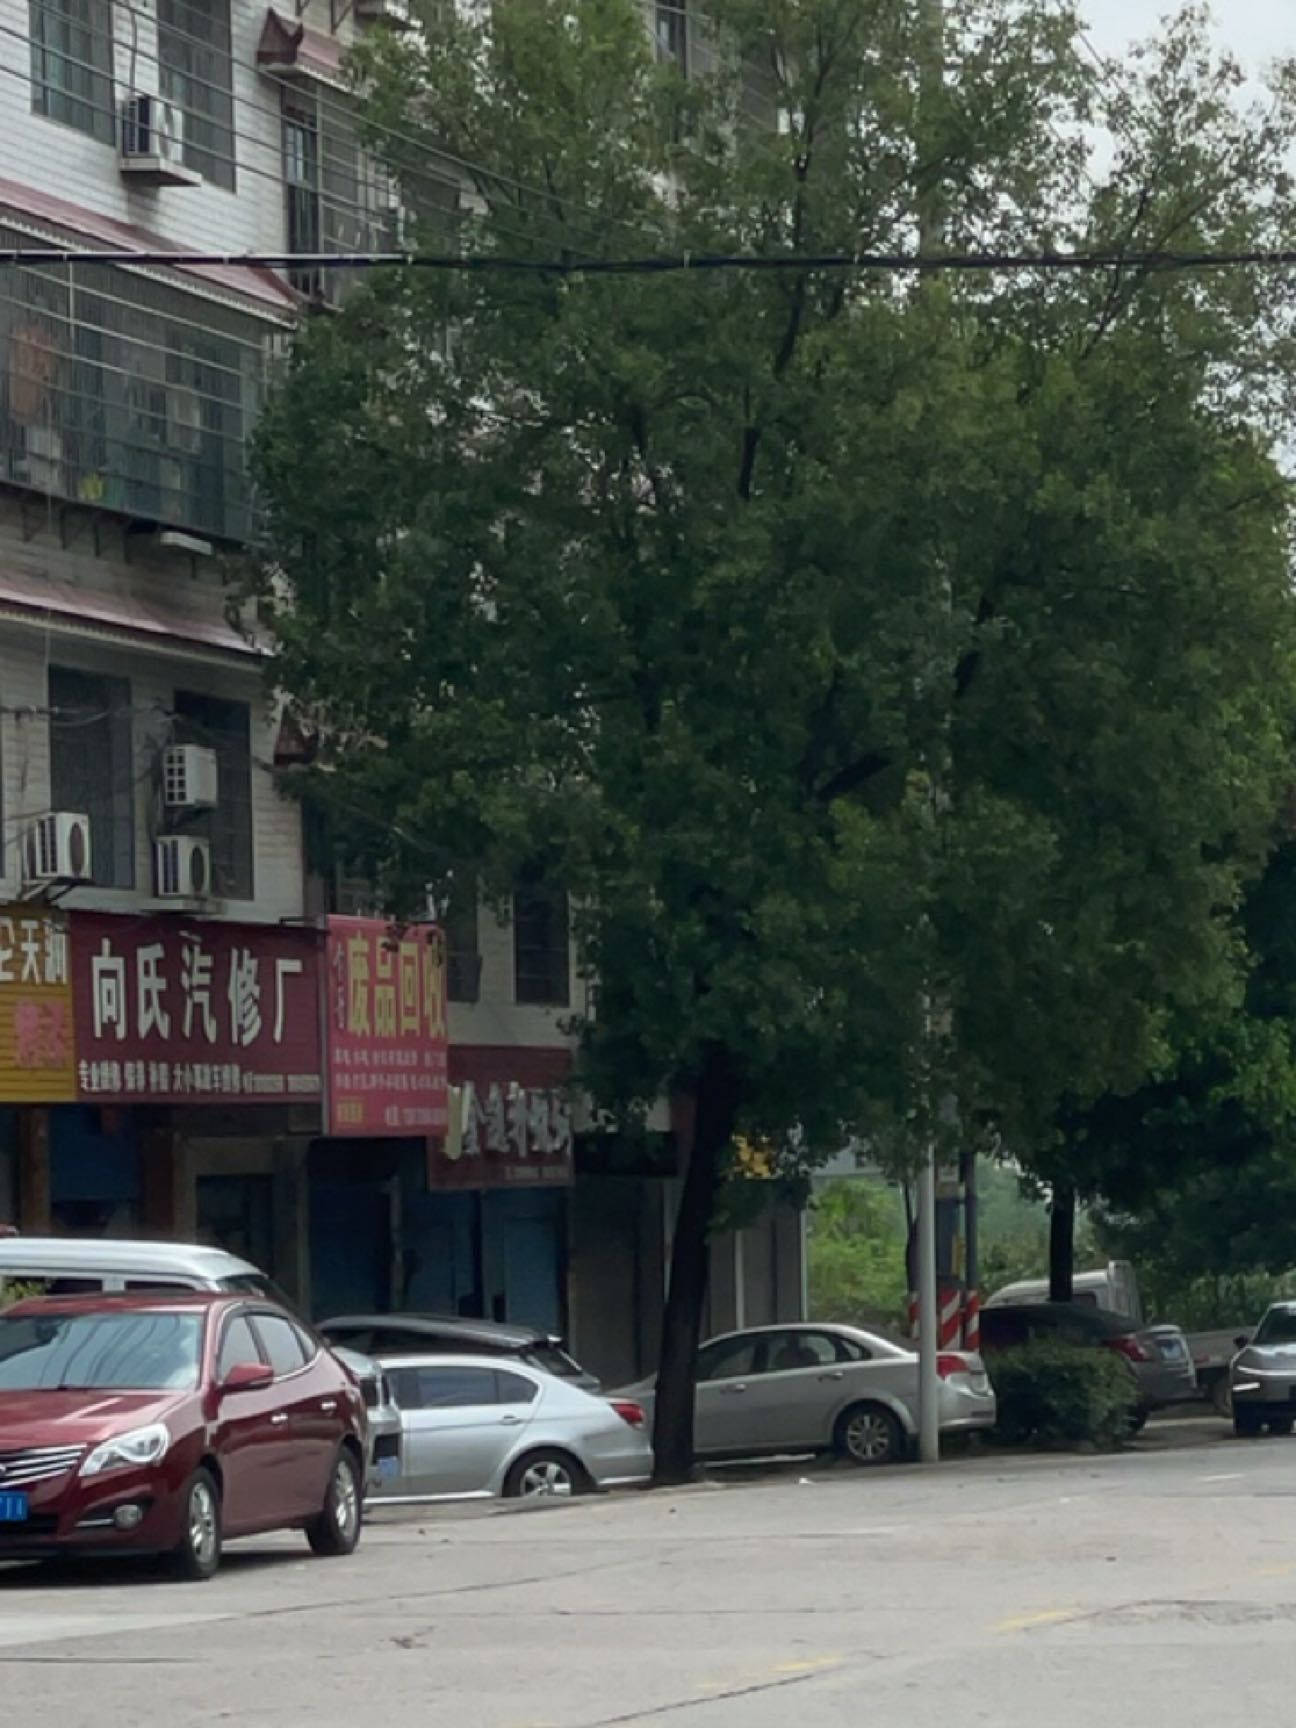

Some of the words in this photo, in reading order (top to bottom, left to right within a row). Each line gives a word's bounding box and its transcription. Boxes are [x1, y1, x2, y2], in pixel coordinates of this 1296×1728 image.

[91, 930, 303, 1047] 向氏汽修厂
[347, 930, 446, 1038] 废品回收
